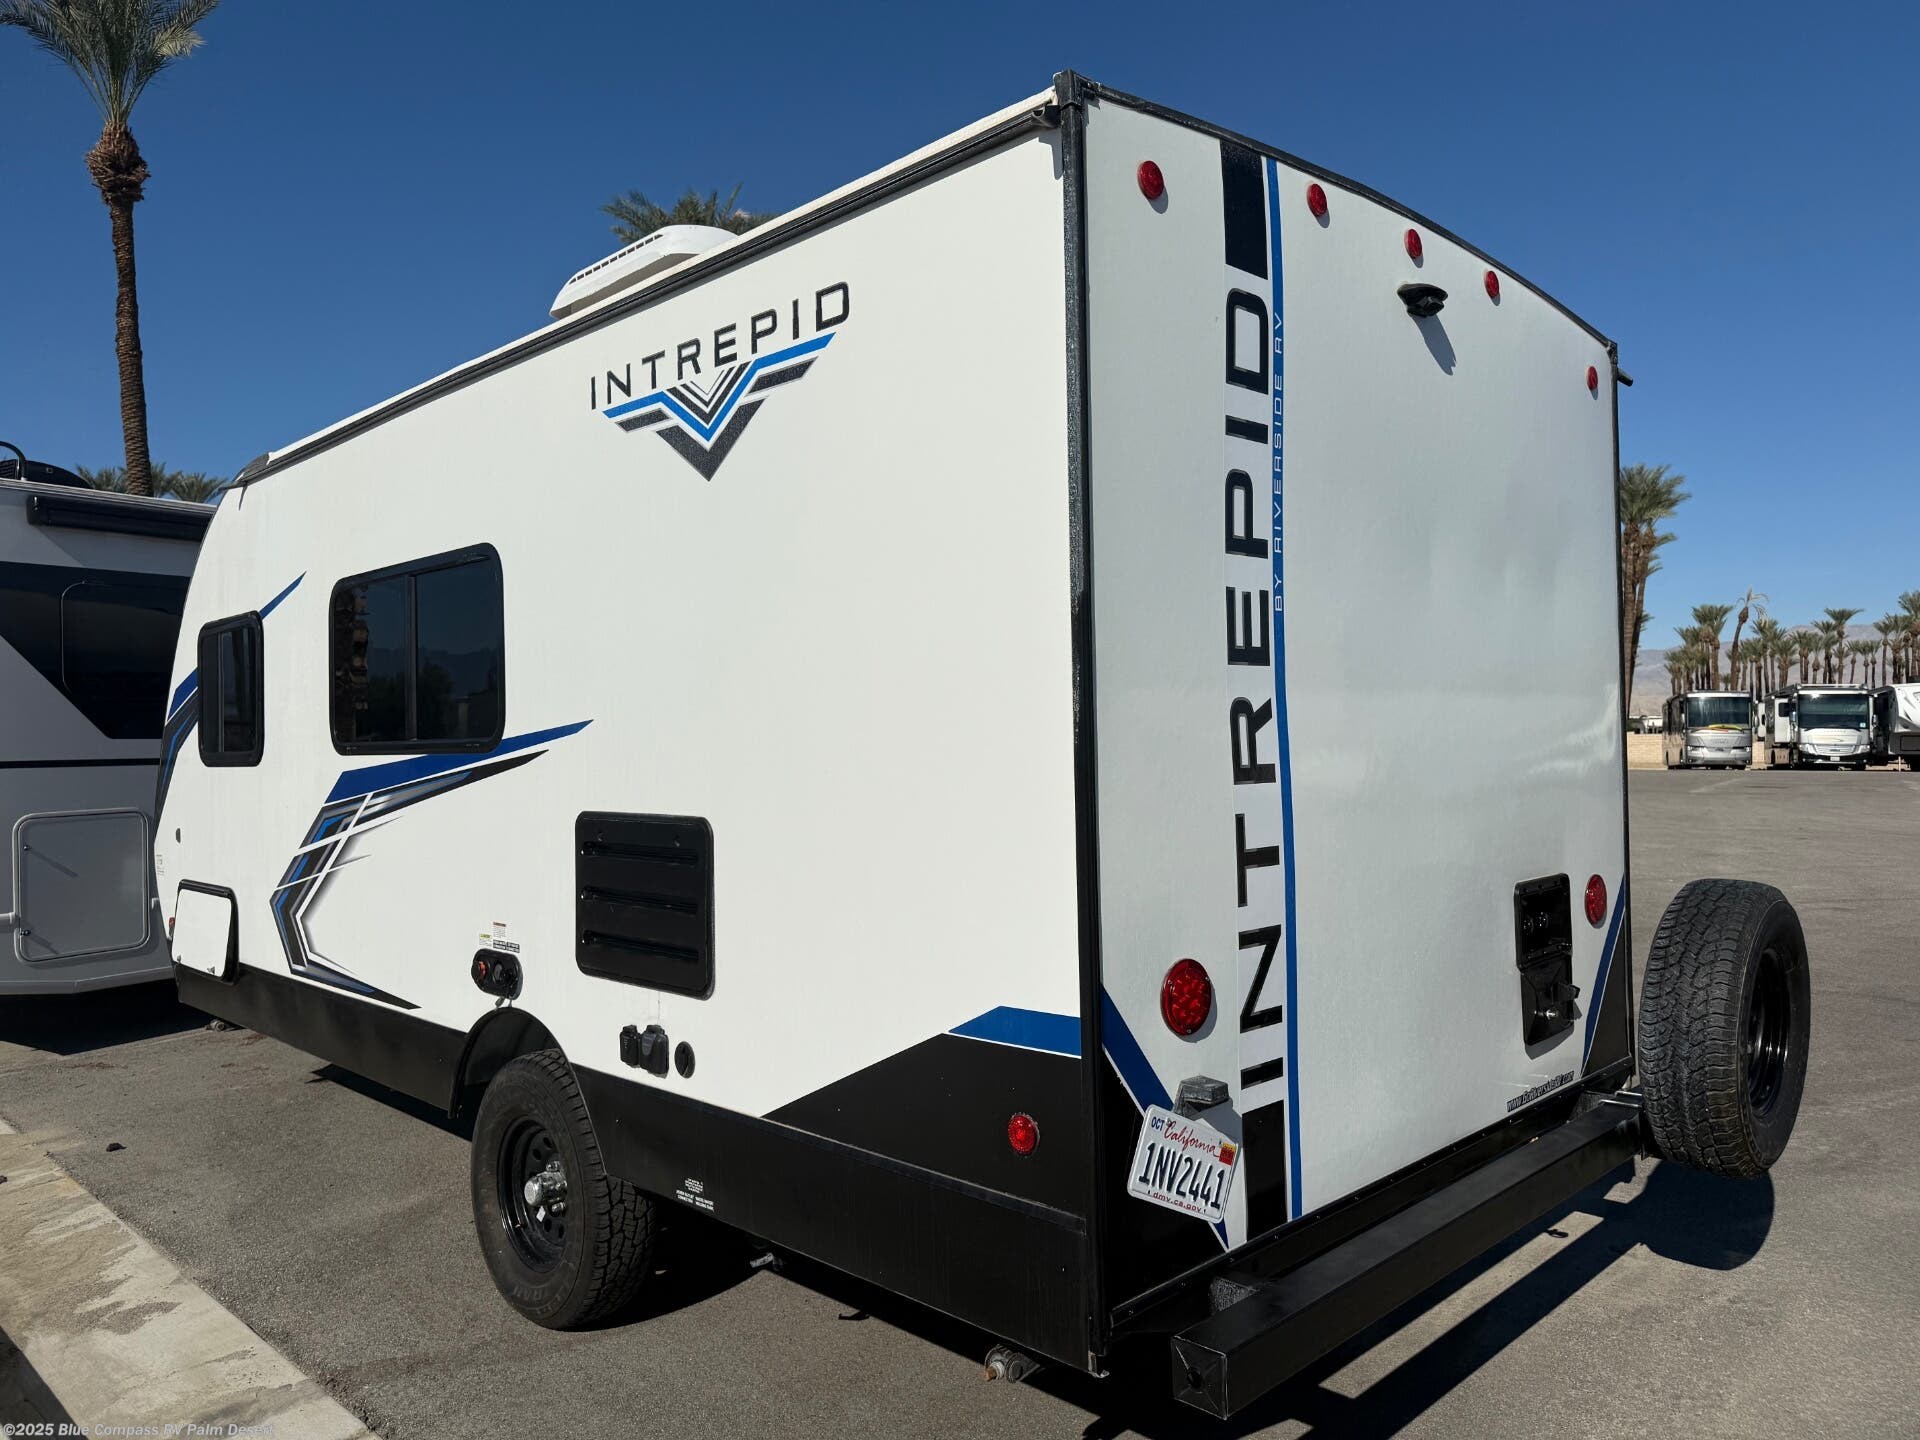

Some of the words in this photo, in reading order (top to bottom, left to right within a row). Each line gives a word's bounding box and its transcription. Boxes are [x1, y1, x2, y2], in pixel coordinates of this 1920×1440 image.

[590, 281, 850, 411] INTREPID
[1273, 373, 1283, 554] RIVERSIDE
[1274, 573, 1283, 612] BY
[1224, 287, 1284, 1091] INTREPID
[1151, 1116, 1166, 1132] OCT
[1163, 1120, 1220, 1158] California
[1138, 1142, 1225, 1210] 1NV2441
[1152, 1191, 1202, 1213] dmv.ca.gov
